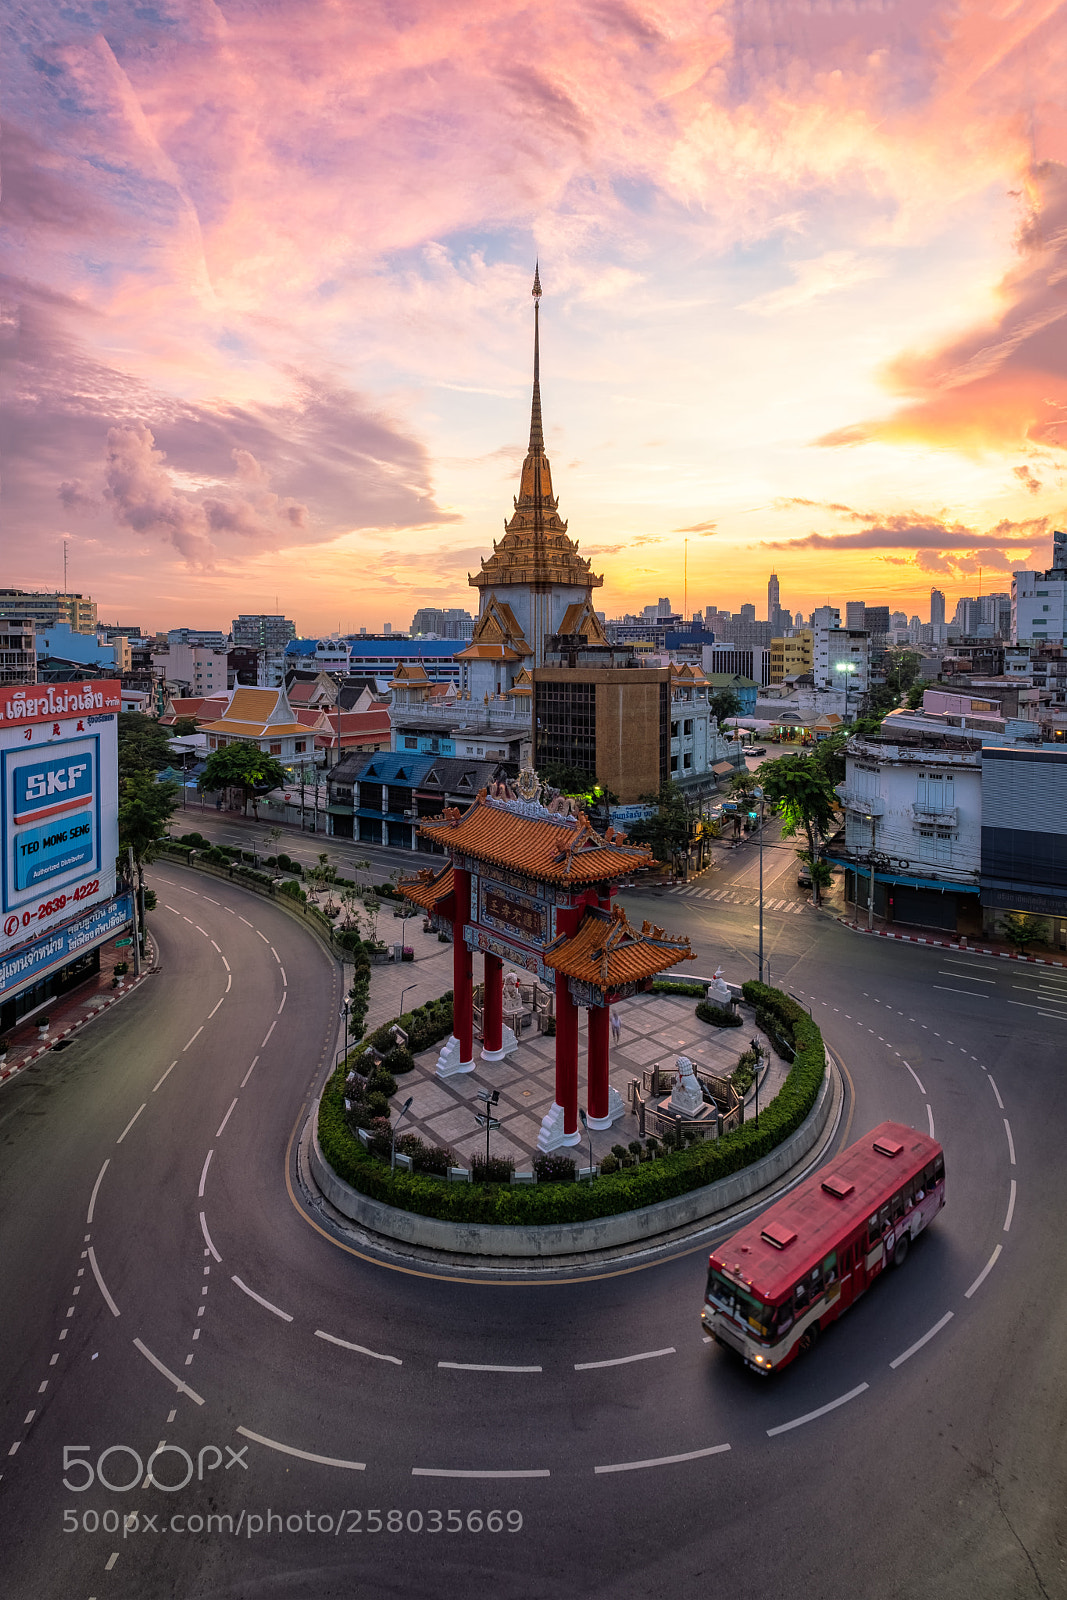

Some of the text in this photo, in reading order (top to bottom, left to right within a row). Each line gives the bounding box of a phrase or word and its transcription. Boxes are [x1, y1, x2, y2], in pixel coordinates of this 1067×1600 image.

[6, 685, 103, 719] เตียวโม่วเส็ง
[26, 763, 87, 801] SKF
[20, 823, 91, 857] TEO MONG SENG
[33, 852, 85, 879] Authorized Distributor
[22, 879, 100, 927] 0-2639-4222
